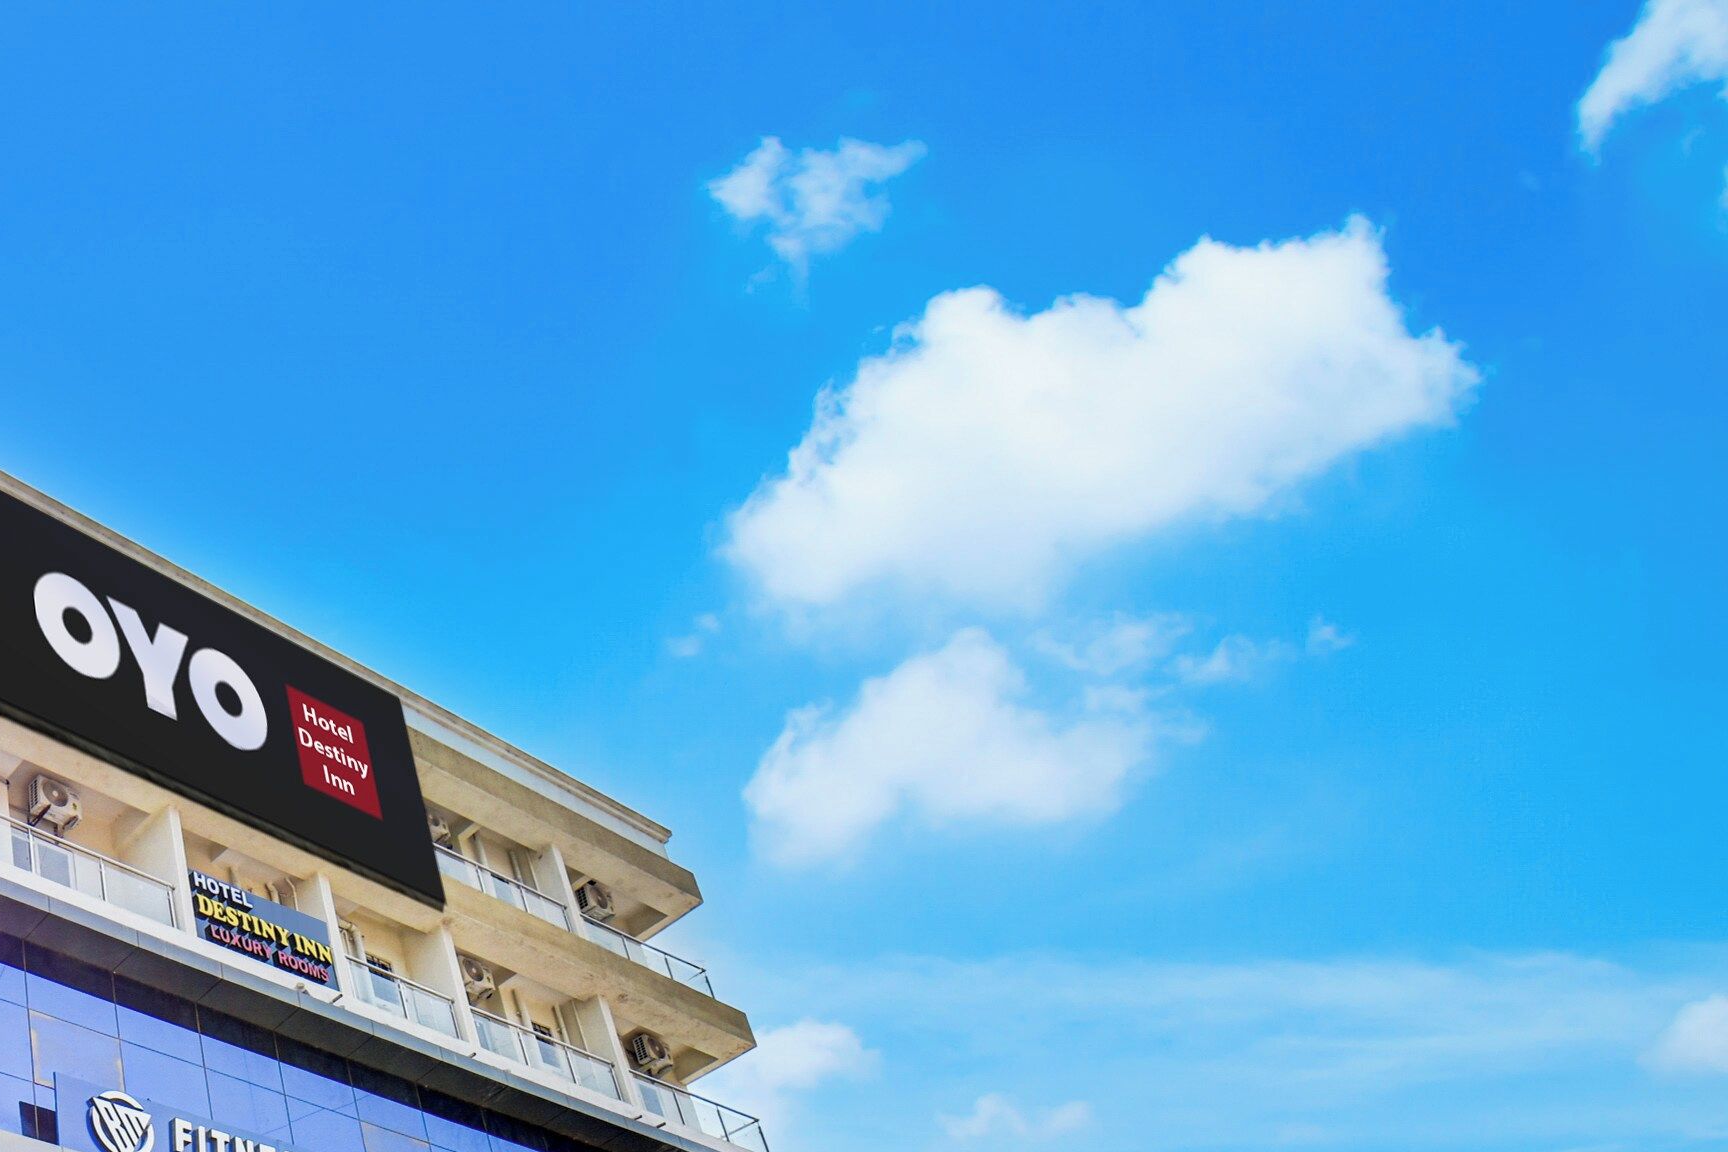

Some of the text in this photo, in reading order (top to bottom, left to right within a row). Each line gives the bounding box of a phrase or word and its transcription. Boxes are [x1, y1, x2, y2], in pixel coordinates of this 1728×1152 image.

[33, 572, 268, 751] OYO
[302, 704, 353, 744] Hotel
[298, 727, 368, 779] Destiny
[323, 765, 355, 796] Inn
[193, 872, 253, 908] HOTEL
[196, 894, 333, 964] DESTINY INN
[211, 925, 329, 981] LUXURY ROOMS
